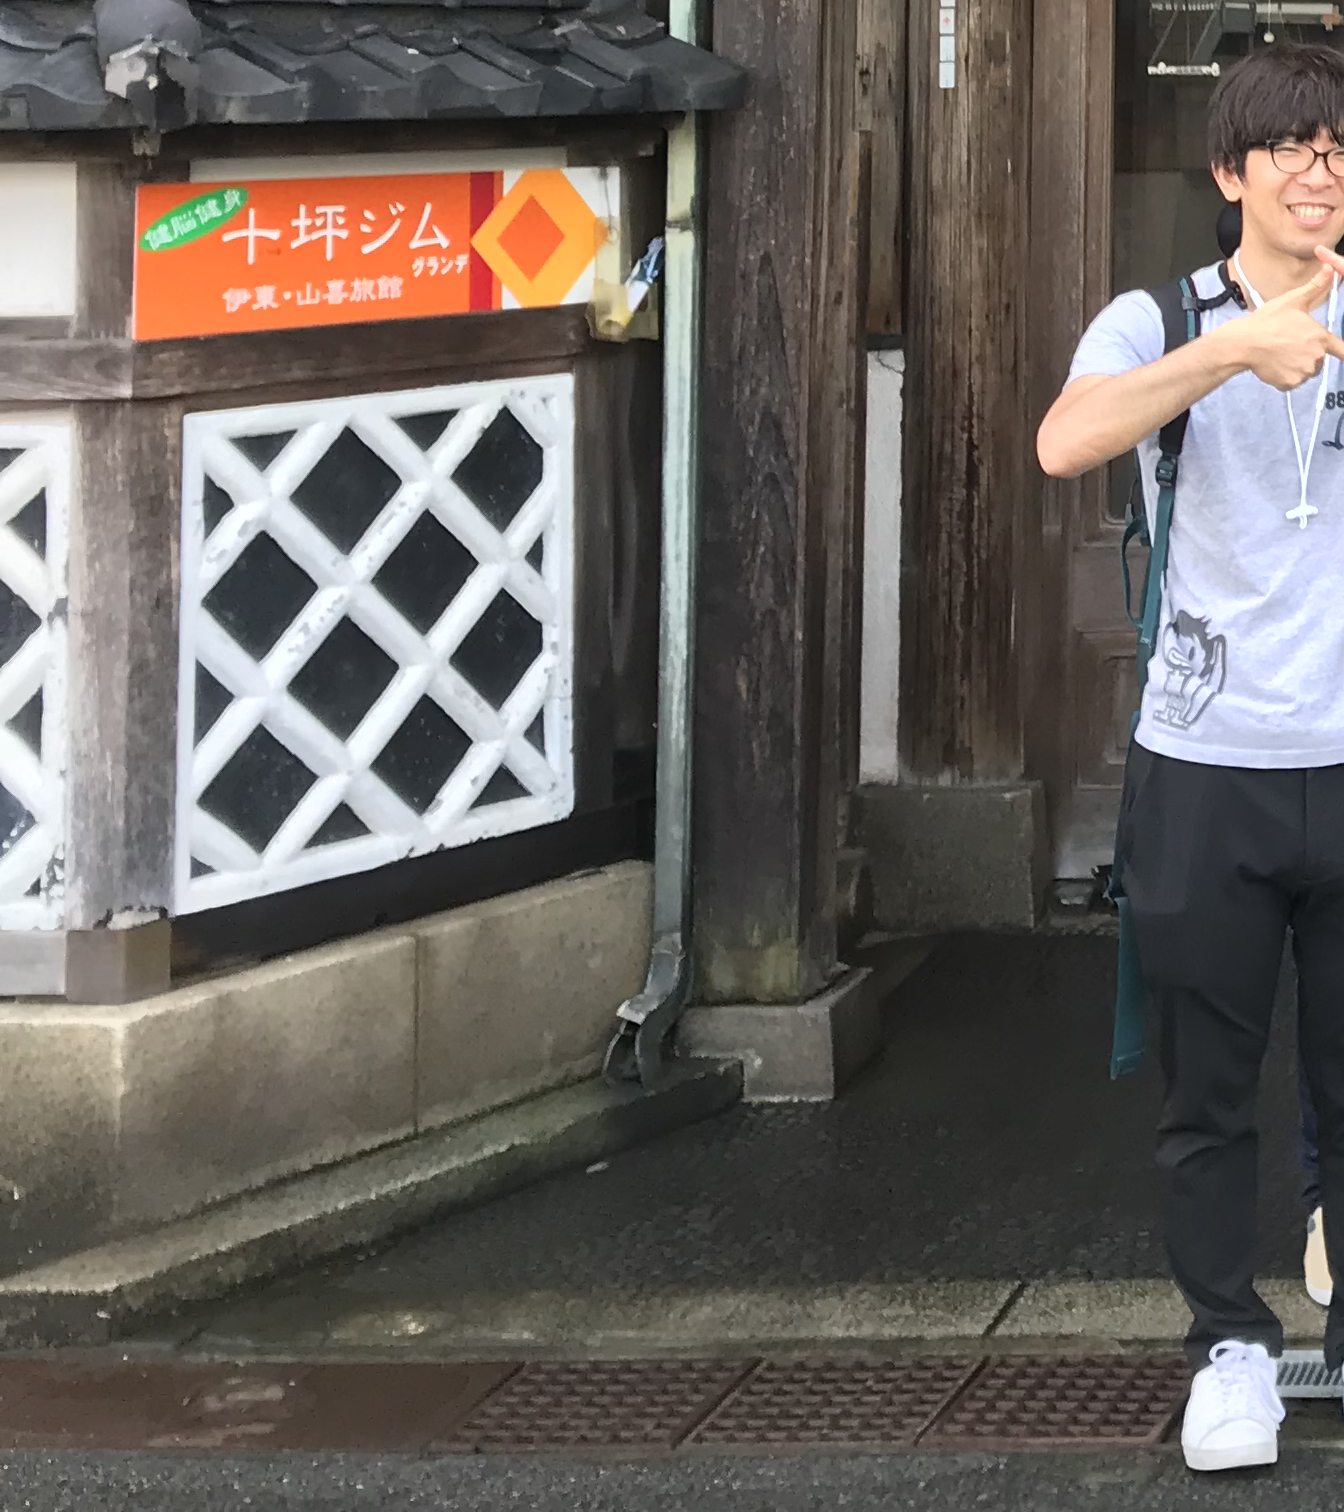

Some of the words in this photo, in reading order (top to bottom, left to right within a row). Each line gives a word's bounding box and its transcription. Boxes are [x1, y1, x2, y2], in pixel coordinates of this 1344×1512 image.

[222, 201, 450, 265] 十坪ジム
[411, 254, 469, 278] グランデ
[221, 275, 404, 313] 伊東・山喜旅館
